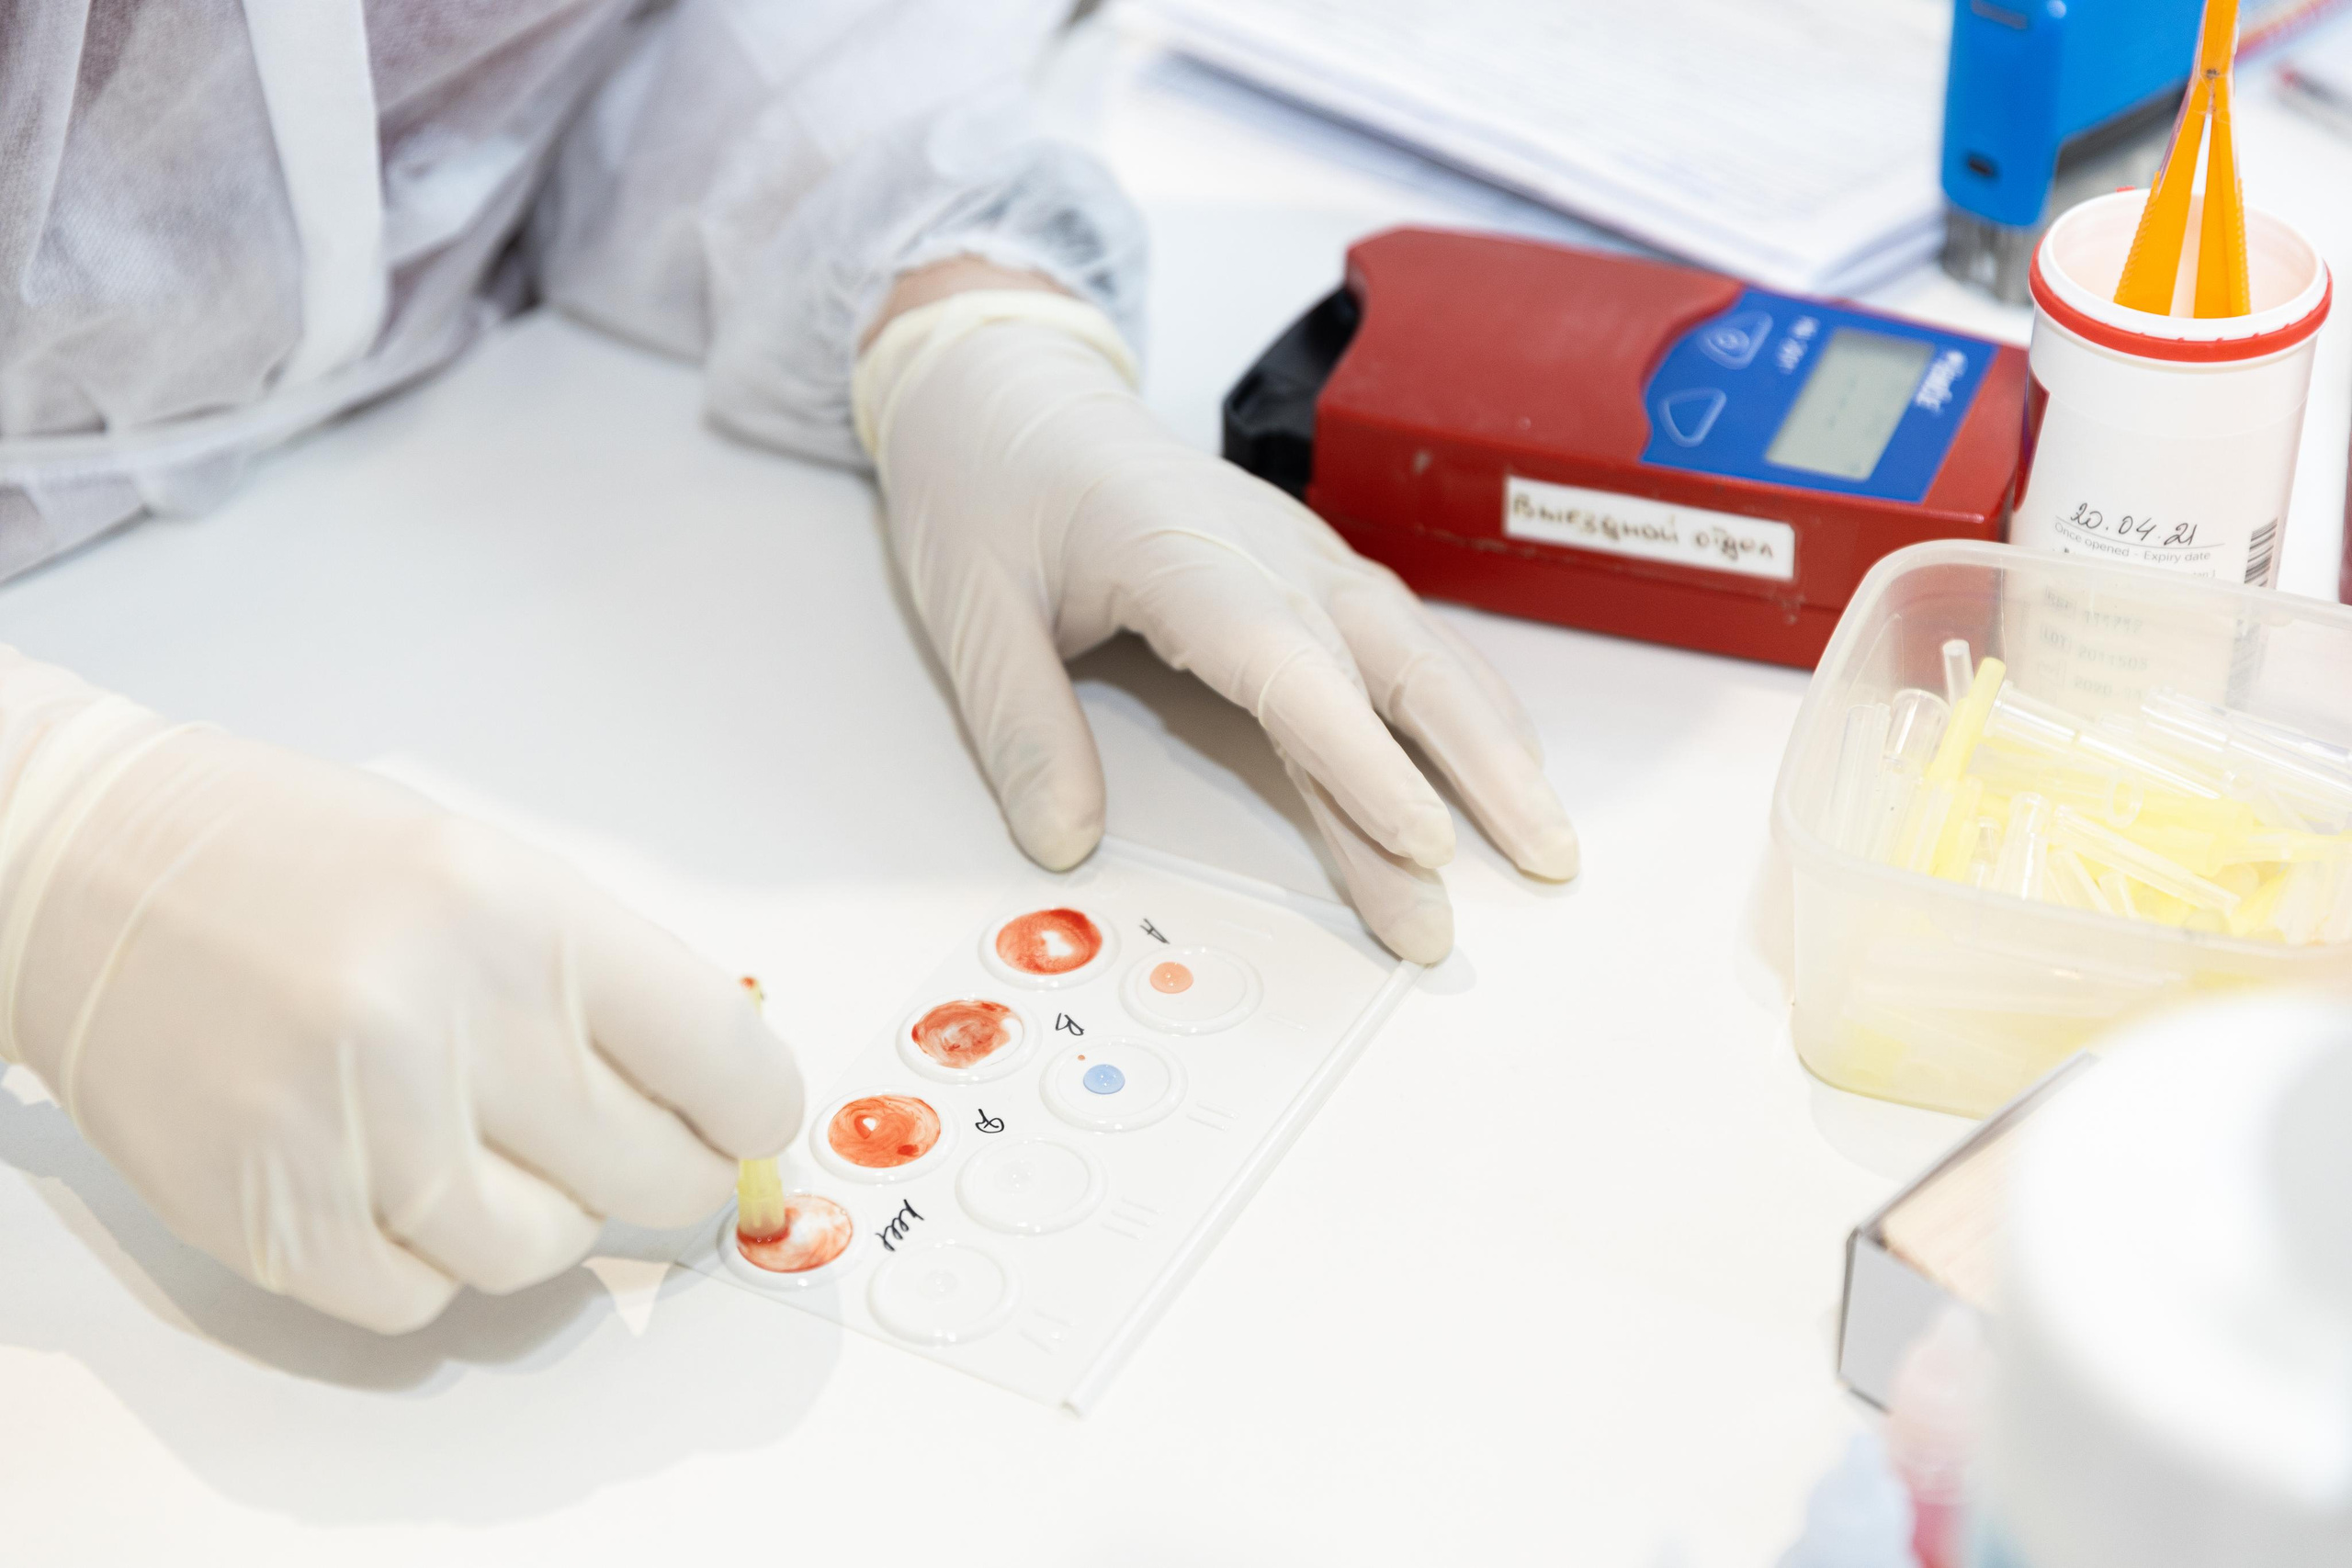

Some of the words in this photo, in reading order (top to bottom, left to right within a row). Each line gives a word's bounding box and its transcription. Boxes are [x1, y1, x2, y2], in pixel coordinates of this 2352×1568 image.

[2054, 521, 2082, 544] Once
[2085, 537, 2130, 558] opened
[2143, 550, 2184, 565] Expiry
[2184, 551, 2211, 562] date
[1139, 919, 1170, 944] A
[1056, 1013, 1085, 1036] B
